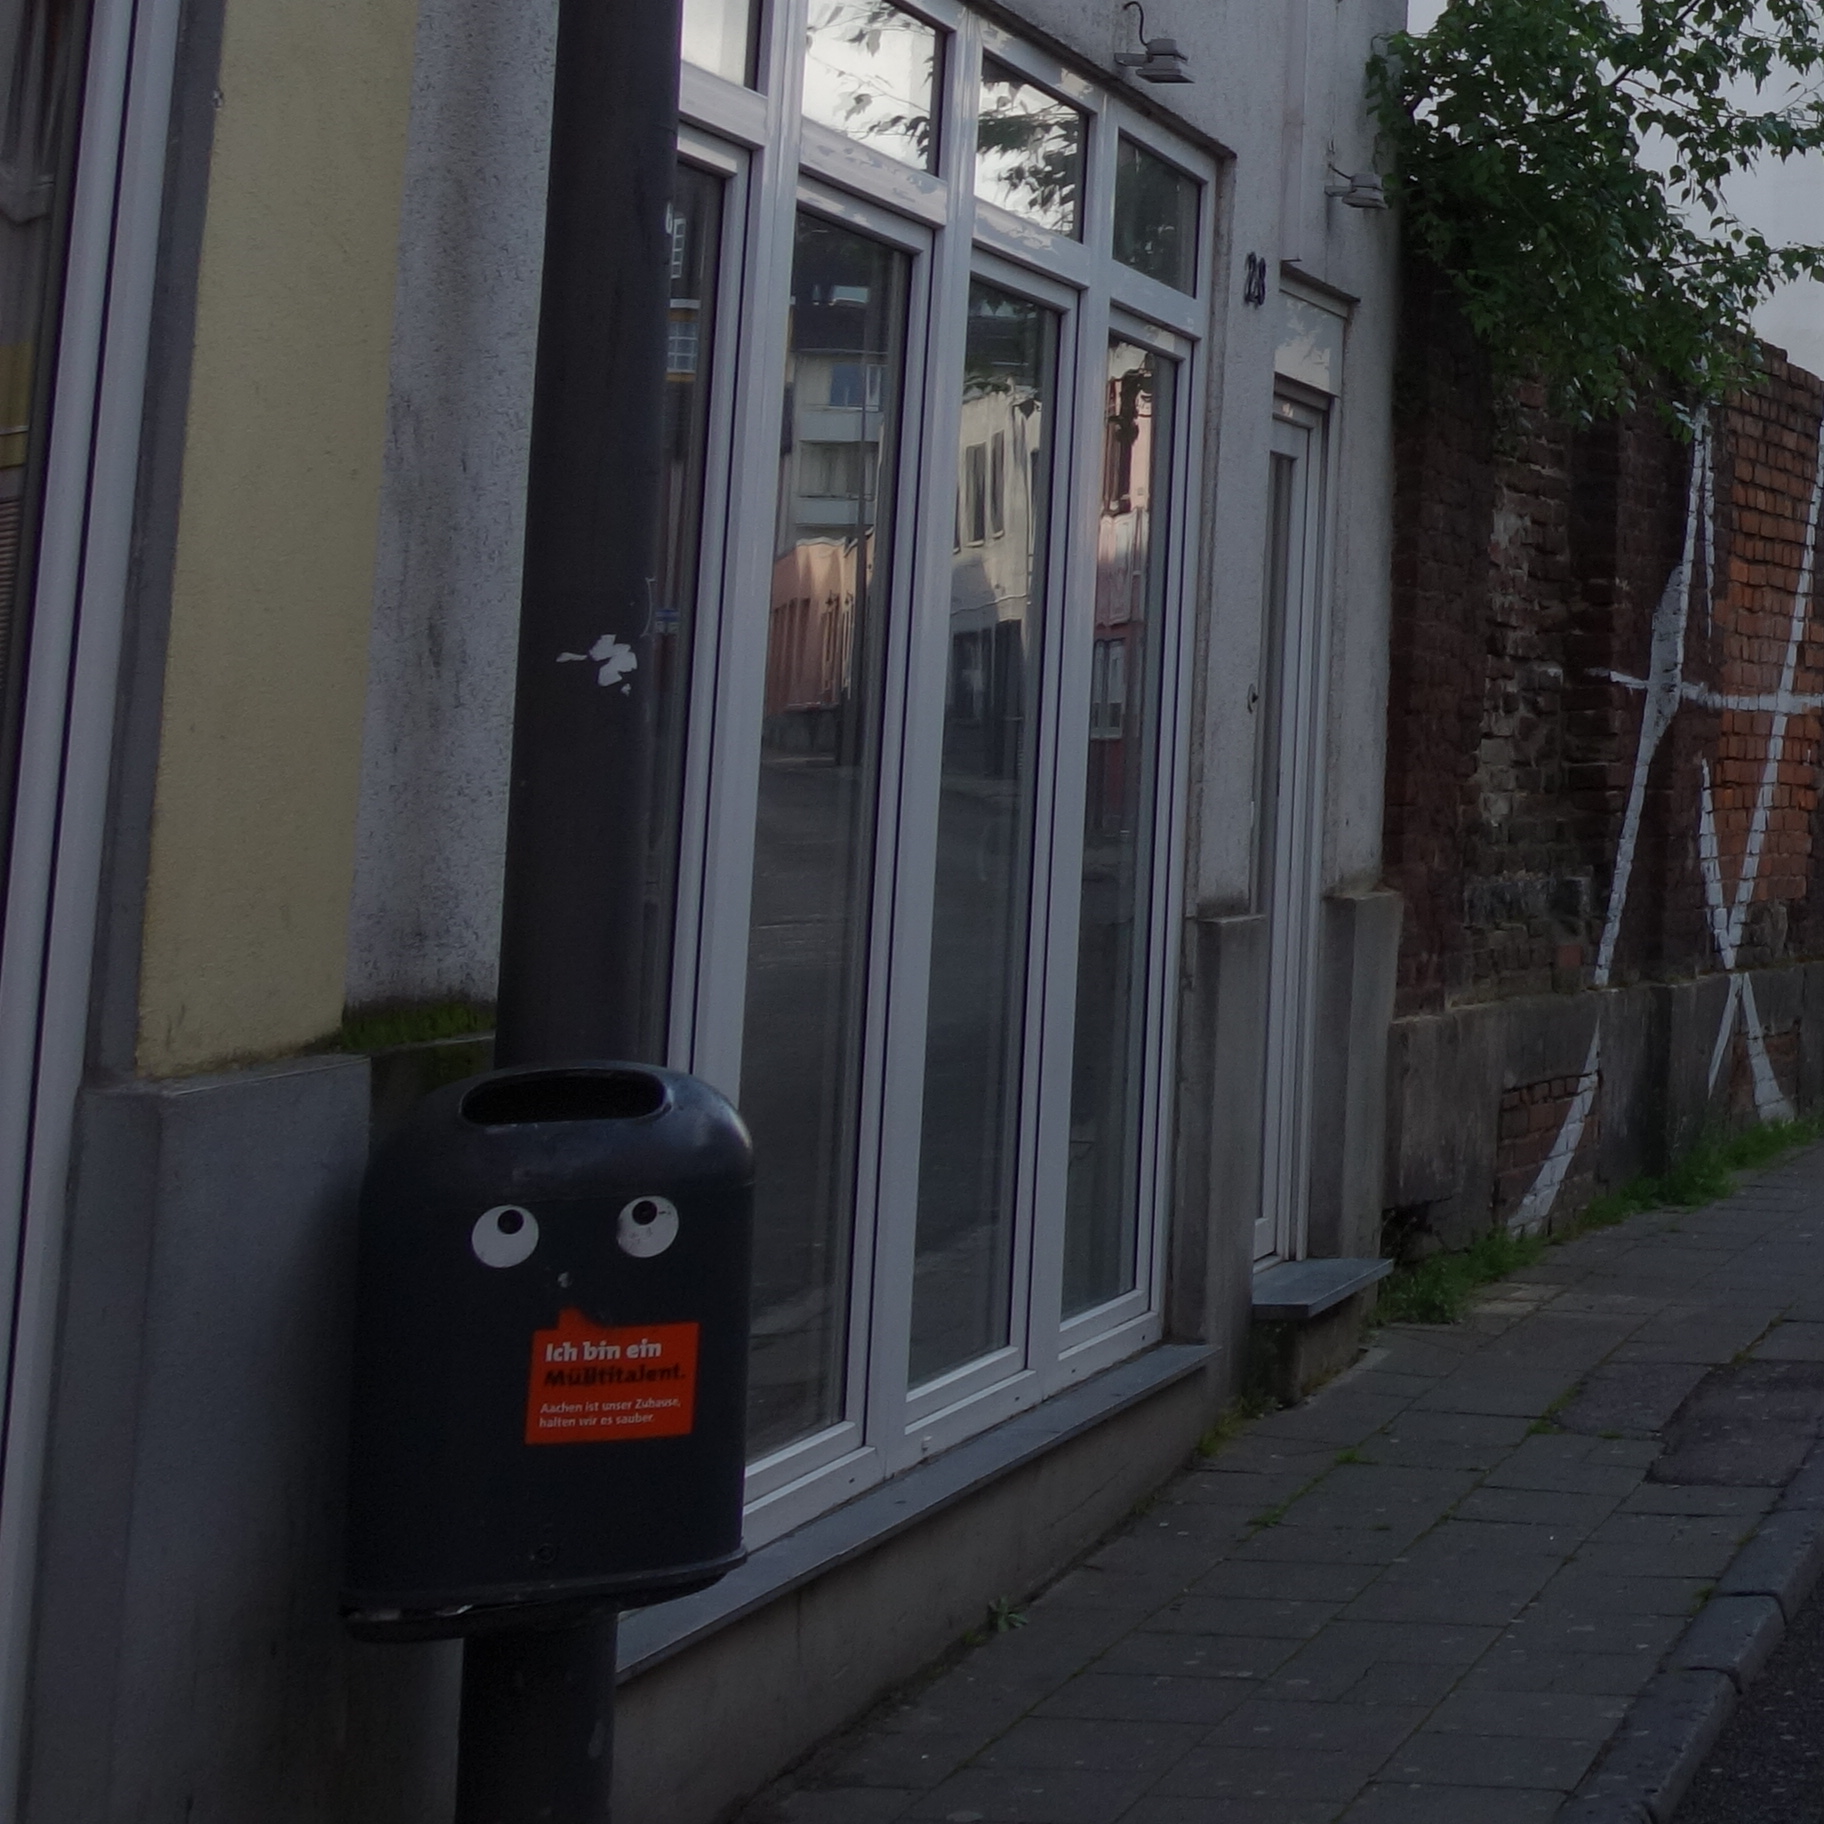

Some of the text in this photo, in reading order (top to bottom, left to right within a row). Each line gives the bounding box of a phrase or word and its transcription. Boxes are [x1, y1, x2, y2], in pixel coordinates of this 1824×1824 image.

[1244, 252, 1267, 310] 28
[545, 1338, 662, 1362] Ich bin ein
[540, 1400, 582, 1414] Aachen
[585, 1401, 599, 1412] ist
[602, 1401, 632, 1411] unser
[539, 1416, 576, 1428] halten
[579, 1415, 597, 1426] wir
[600, 1416, 613, 1425] es
